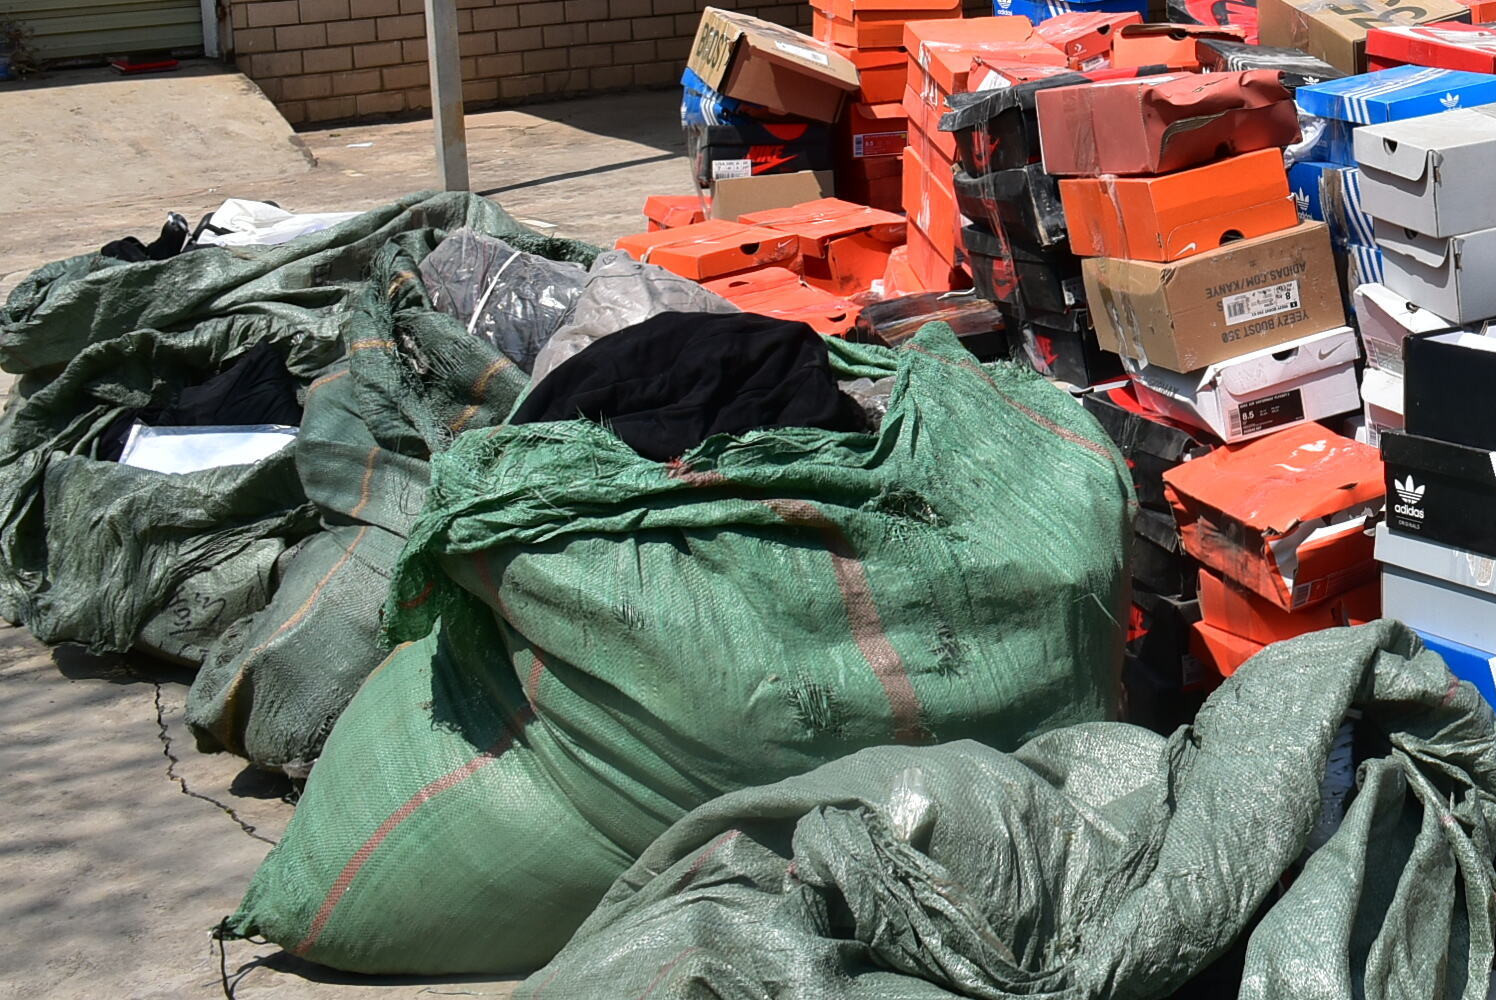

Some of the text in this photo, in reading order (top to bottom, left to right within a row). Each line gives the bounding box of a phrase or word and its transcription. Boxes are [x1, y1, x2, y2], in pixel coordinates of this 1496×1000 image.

[1205, 260, 1307, 299] ADIDAS.COM/KANYE
[1277, 310, 1310, 327] YEEZY
[1221, 328, 1241, 344] 350
[1243, 319, 1275, 337] BOOST
[1242, 410, 1255, 421] 8.5
[1394, 503, 1425, 520] adidas
